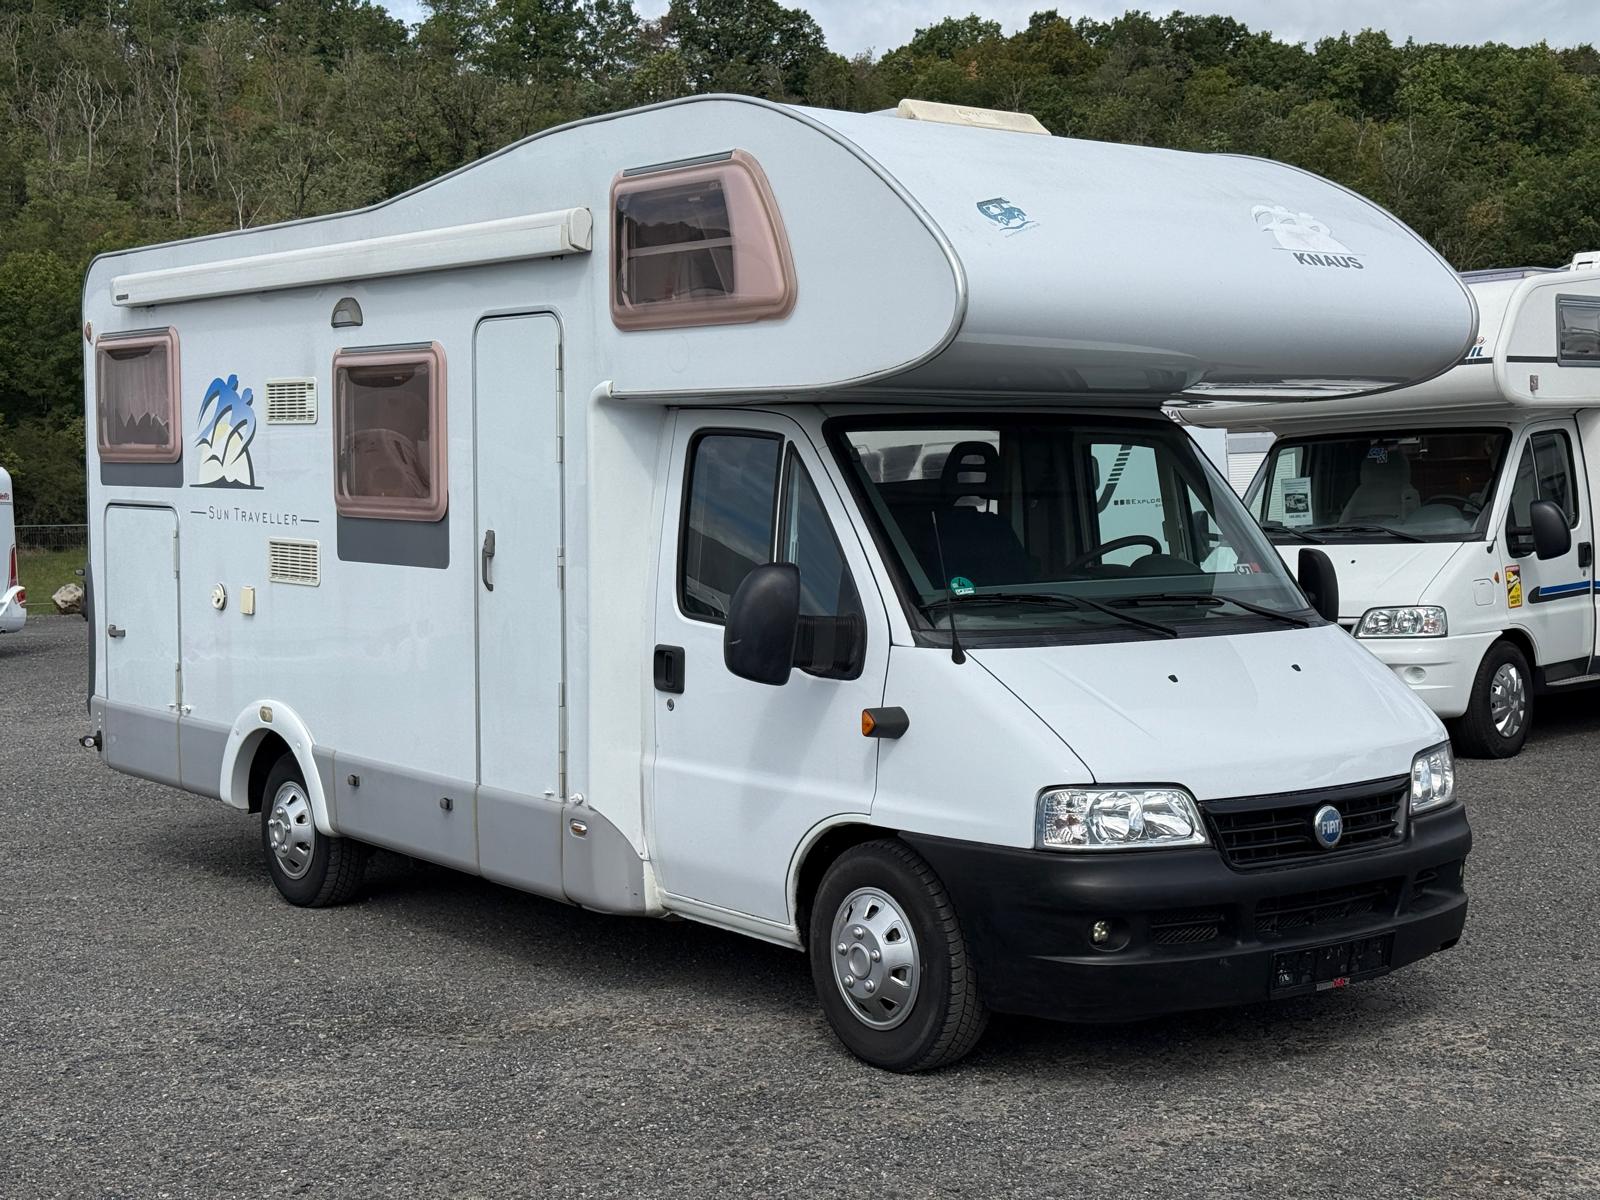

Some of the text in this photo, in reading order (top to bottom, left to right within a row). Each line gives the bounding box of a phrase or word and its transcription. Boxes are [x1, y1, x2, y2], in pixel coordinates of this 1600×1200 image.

[1292, 252, 1364, 269] KNAUS
[208, 505, 298, 525] SUN TRAVELLER
[1321, 820, 1340, 835] FIAT
